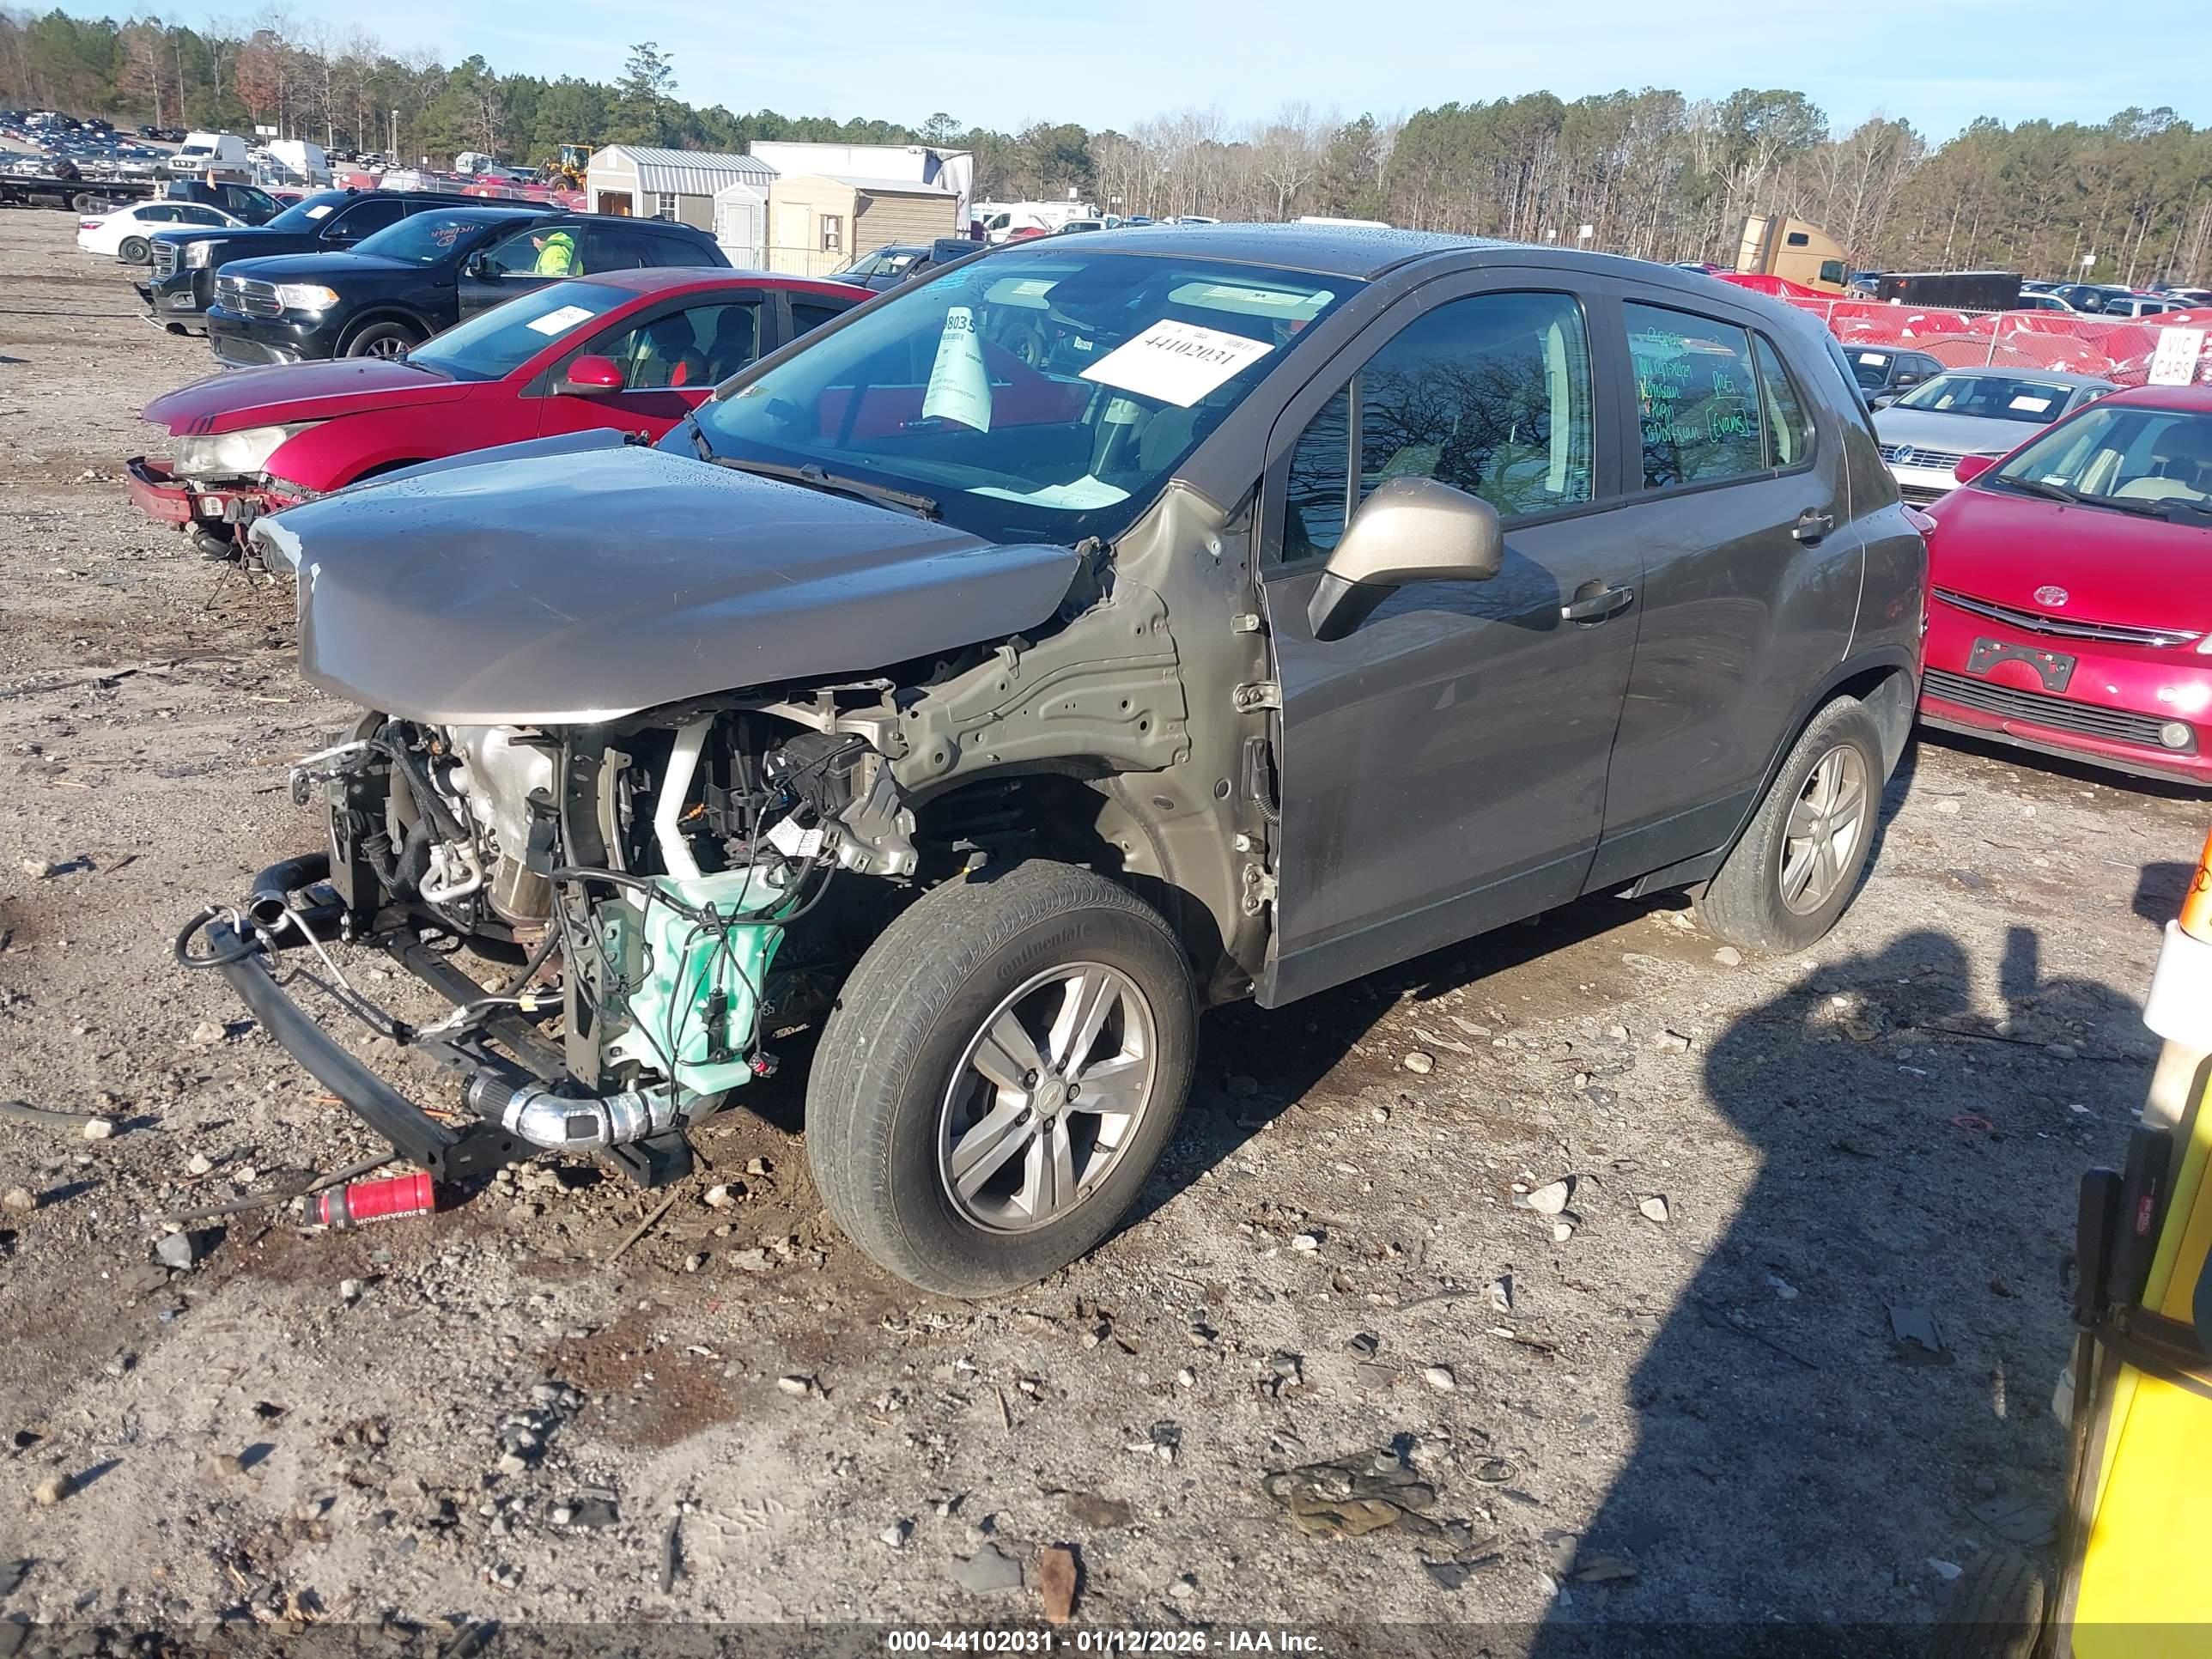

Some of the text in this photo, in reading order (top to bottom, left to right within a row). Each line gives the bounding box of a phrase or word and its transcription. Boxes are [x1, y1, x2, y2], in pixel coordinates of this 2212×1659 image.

[1145, 335, 1237, 365] 44102031
[2167, 336, 2191, 355] VIC
[2155, 360, 2190, 380] CARS
[994, 925, 1082, 982] Continental
